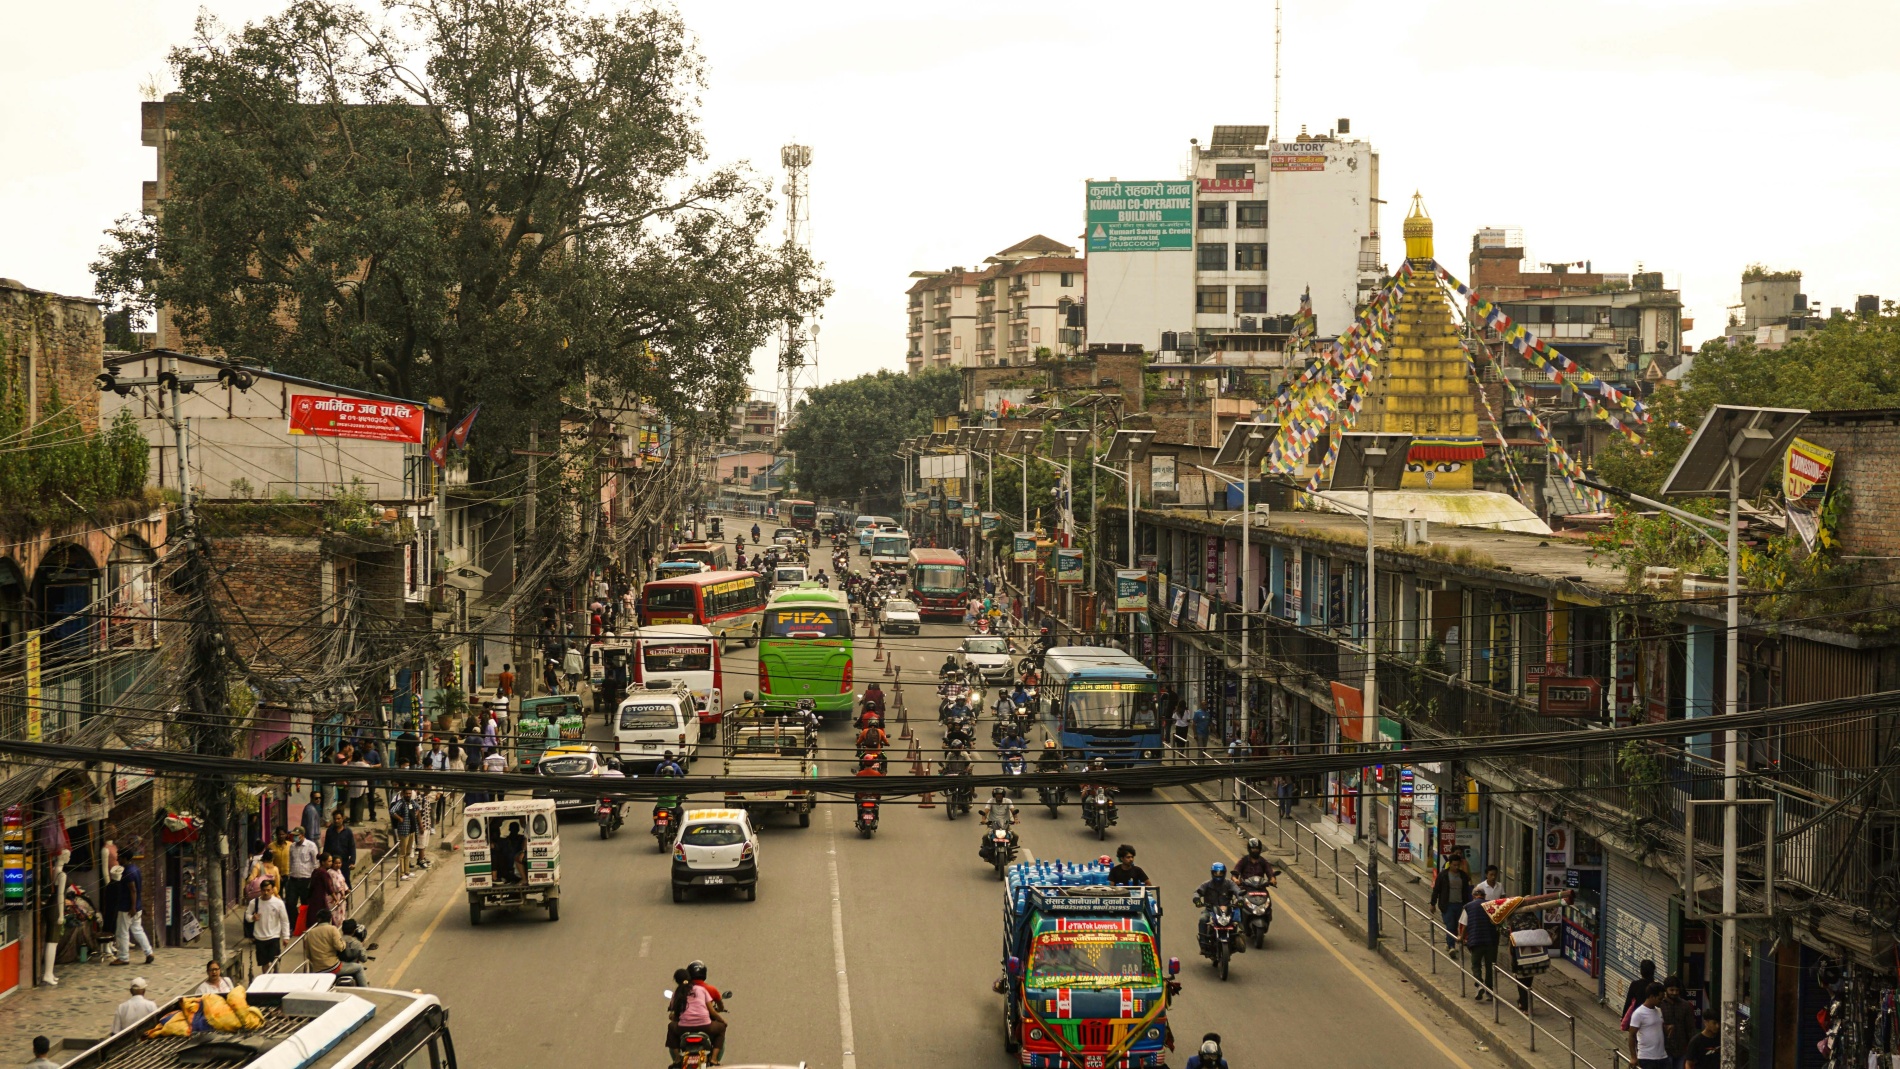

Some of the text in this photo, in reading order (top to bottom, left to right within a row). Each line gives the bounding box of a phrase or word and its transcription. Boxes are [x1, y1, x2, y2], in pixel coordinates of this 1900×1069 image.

[1283, 143, 1325, 151] VICTORY
[1090, 183, 1191, 199] कुमारी सहकारी भवन
[1090, 198, 1192, 211] KUMARI CO-OPERATIVE
[1117, 210, 1163, 222] BUILDING
[1109, 228, 1136, 236] Kumari
[1137, 228, 1161, 237] Saving
[1169, 228, 1192, 236] Credit
[315, 399, 355, 413] मार्मिक
[358, 404, 377, 415] जब
[1792, 453, 1819, 480] ADMISSION
[778, 612, 834, 624] FIFA
[1530, 666, 1546, 674] IME
[1555, 690, 1588, 701] IME
[1415, 783, 1436, 791] OPPO
[1045, 897, 1066, 906] संसार
[1126, 898, 1141, 906] सेवा
